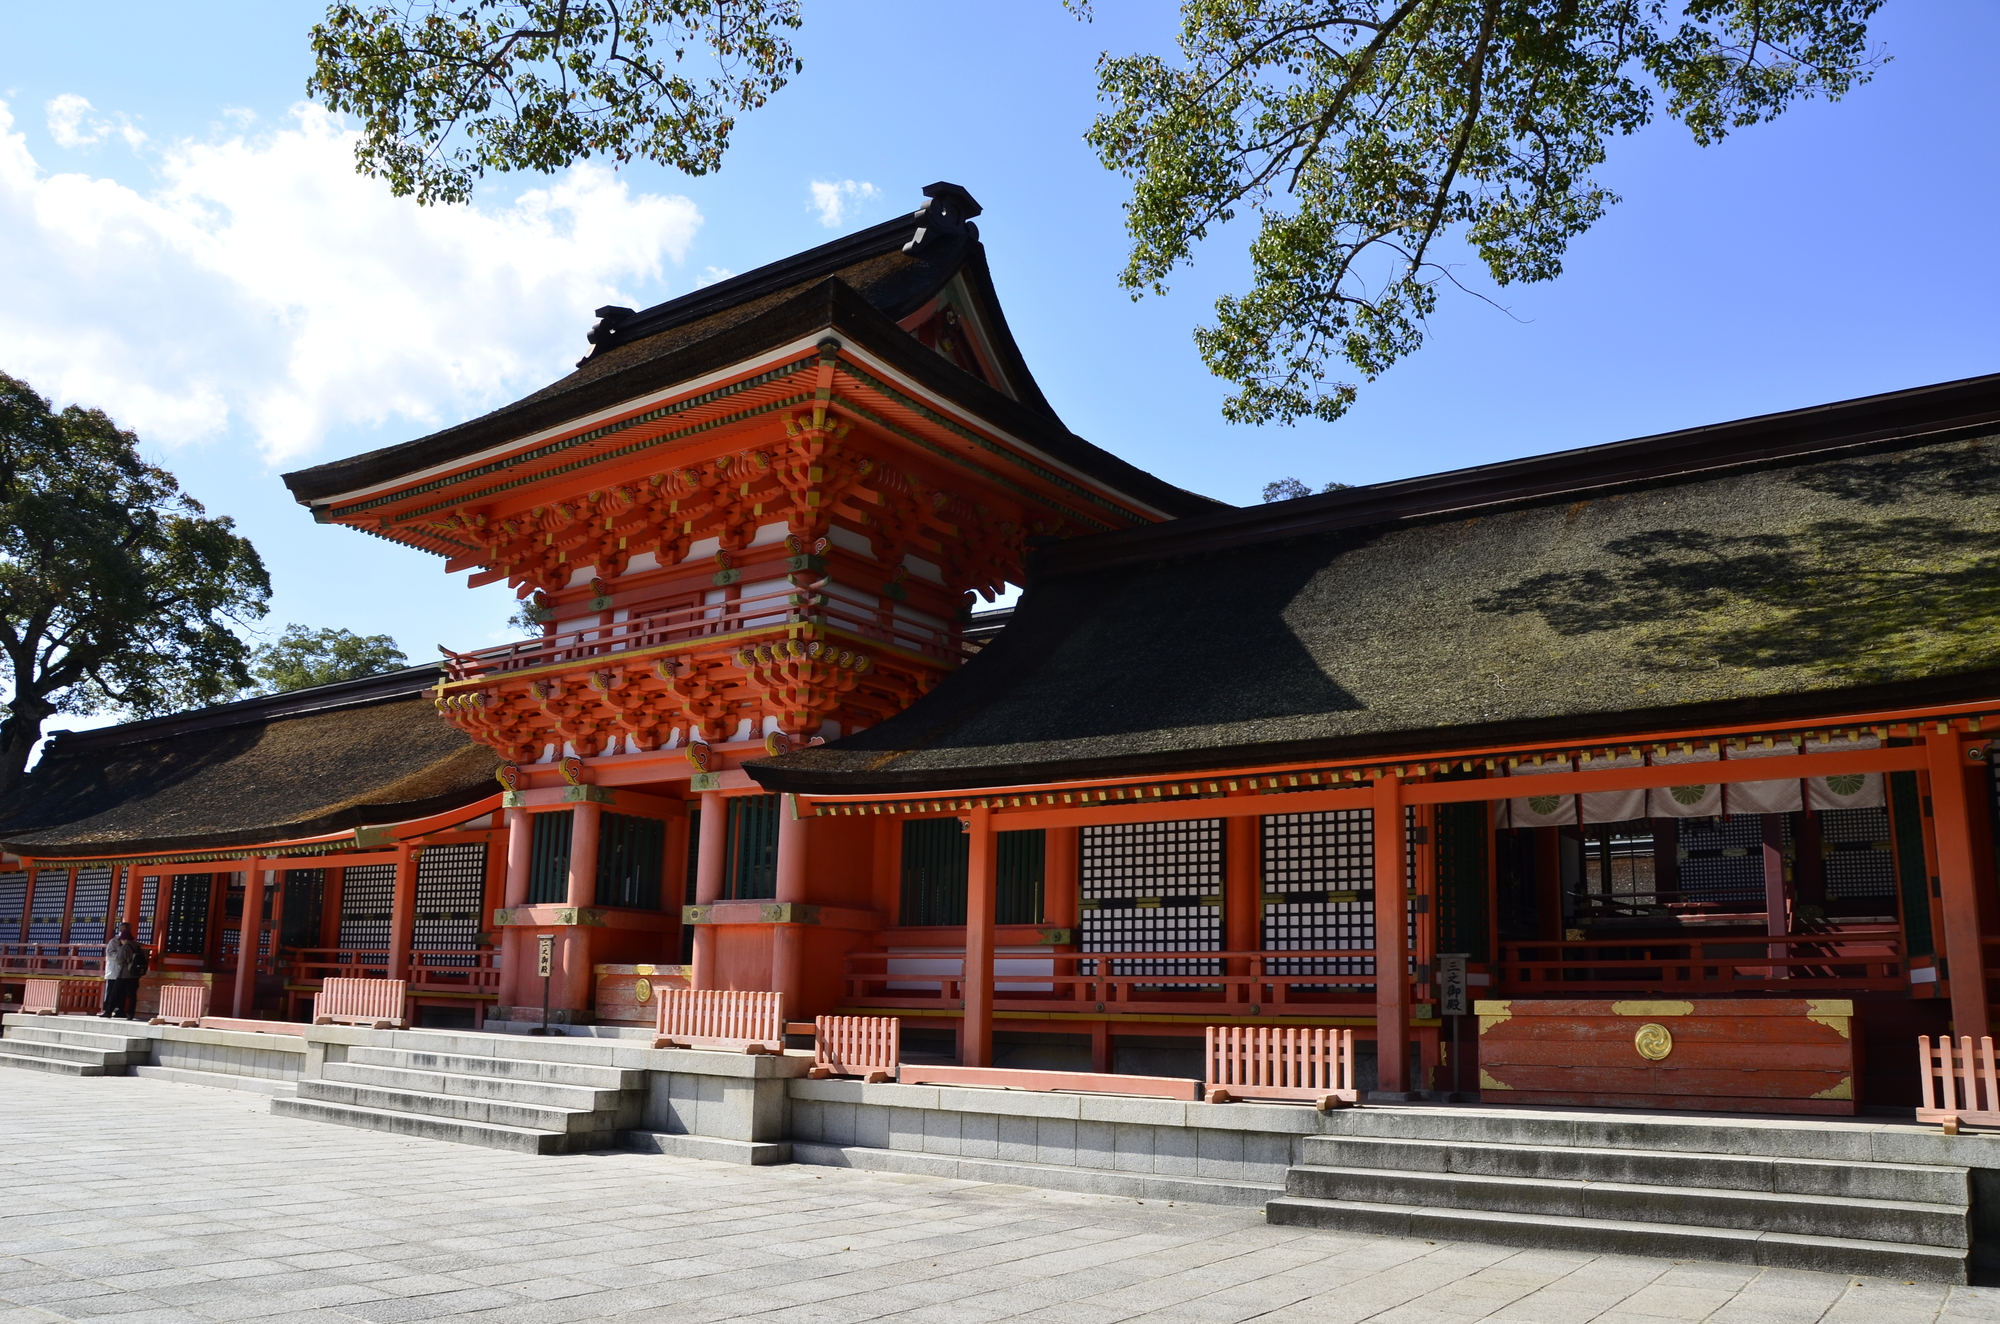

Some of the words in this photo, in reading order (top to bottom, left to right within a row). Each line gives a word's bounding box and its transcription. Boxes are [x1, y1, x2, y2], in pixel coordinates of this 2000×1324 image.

[541, 941, 549, 974] 二之御殿
[1446, 961, 1462, 1011] 三之御殿
